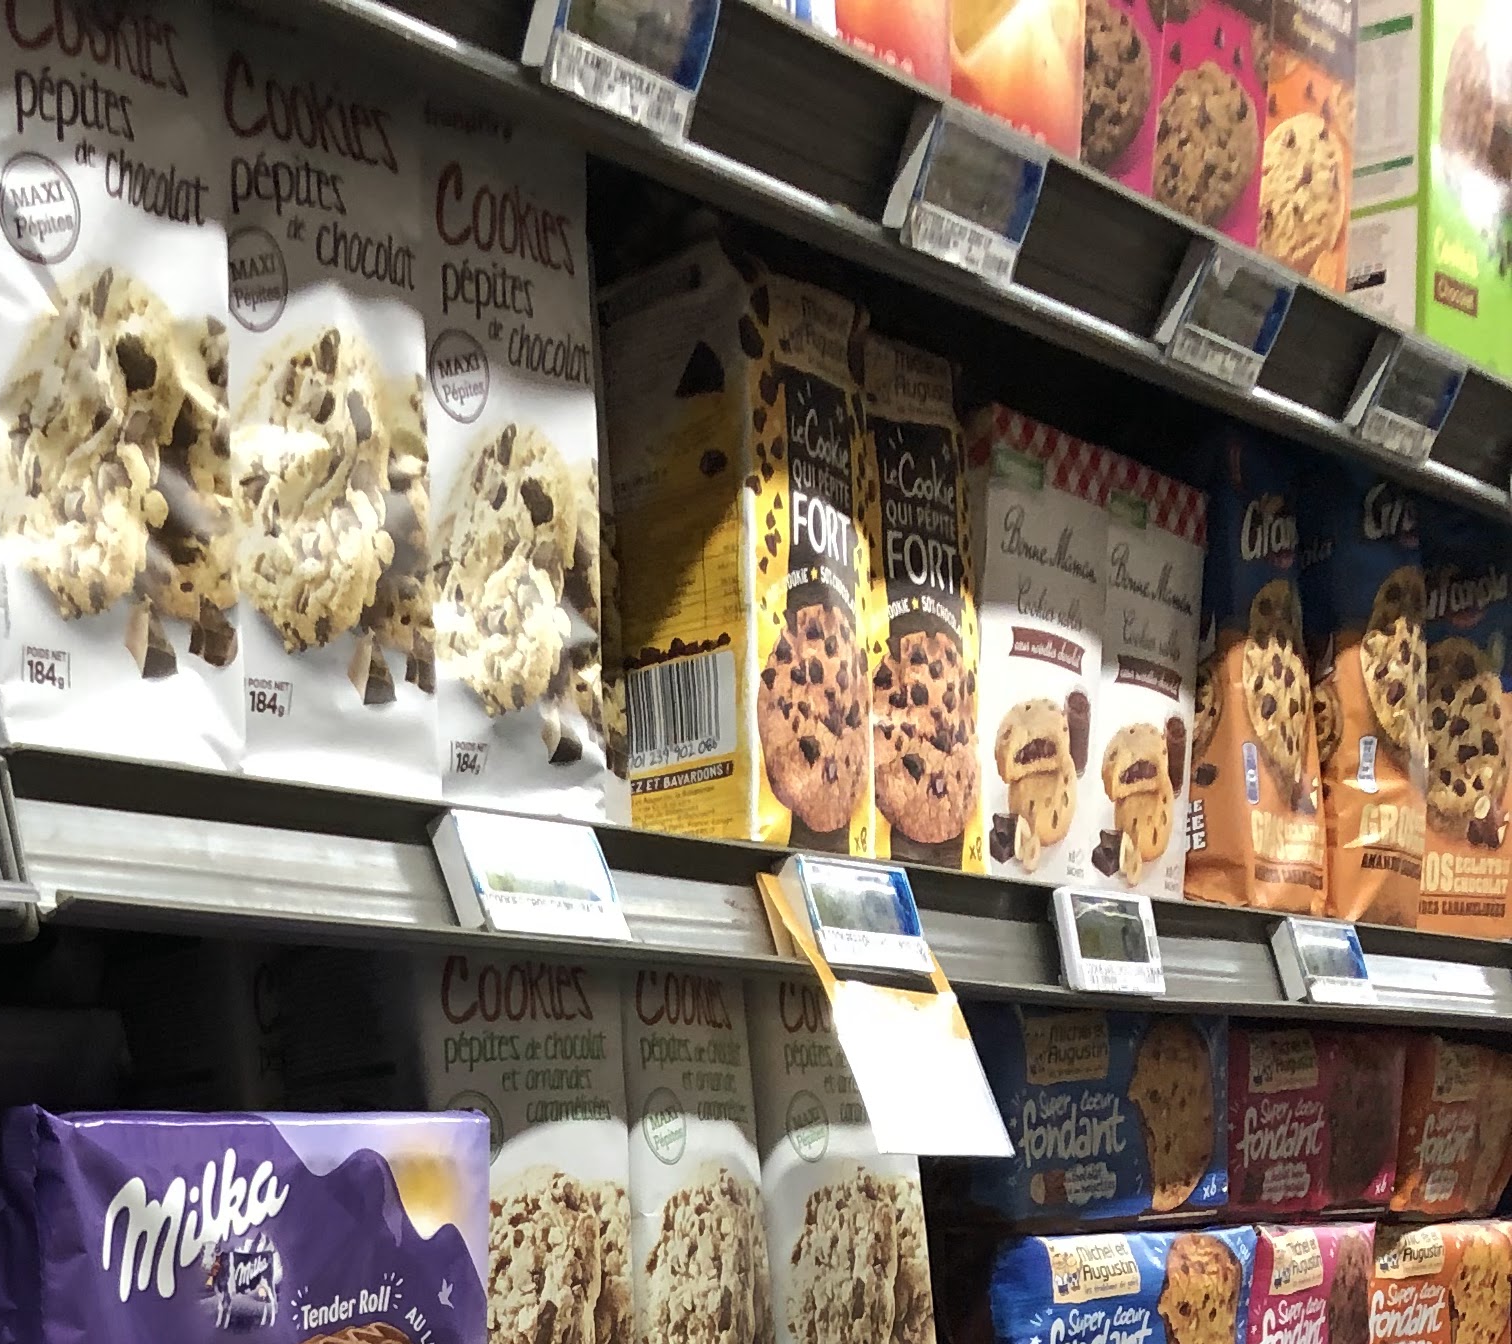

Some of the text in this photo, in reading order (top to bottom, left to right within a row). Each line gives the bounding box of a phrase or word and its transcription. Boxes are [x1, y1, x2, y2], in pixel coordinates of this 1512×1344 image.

[15, 66, 135, 142] pépites
[224, 50, 397, 174] Cookies
[10, 180, 64, 207] MAXI
[104, 146, 210, 226] chocolat
[15, 214, 74, 242] Pépites
[436, 161, 574, 276] Cookies
[230, 253, 275, 280] MAXI
[316, 220, 415, 291] chocolat
[442, 259, 534, 319] pépites
[437, 352, 481, 378] MAXI
[508, 324, 591, 383] chocolat
[442, 380, 486, 404] Pépites
[792, 458, 816, 489] QUI
[792, 491, 851, 566] FORT
[886, 499, 912, 527] QUI
[886, 528, 958, 595] FORT
[27, 659, 65, 690] 184g
[249, 690, 285, 717] 184g
[663, 765, 724, 788] BAVARDONS
[102, 1147, 290, 1304] Milka
[235, 1256, 271, 1287] Milka
[1082, 1258, 1138, 1282] Augustin
[300, 1285, 393, 1331] Tender Roll
[404, 1305, 427, 1333] AU
